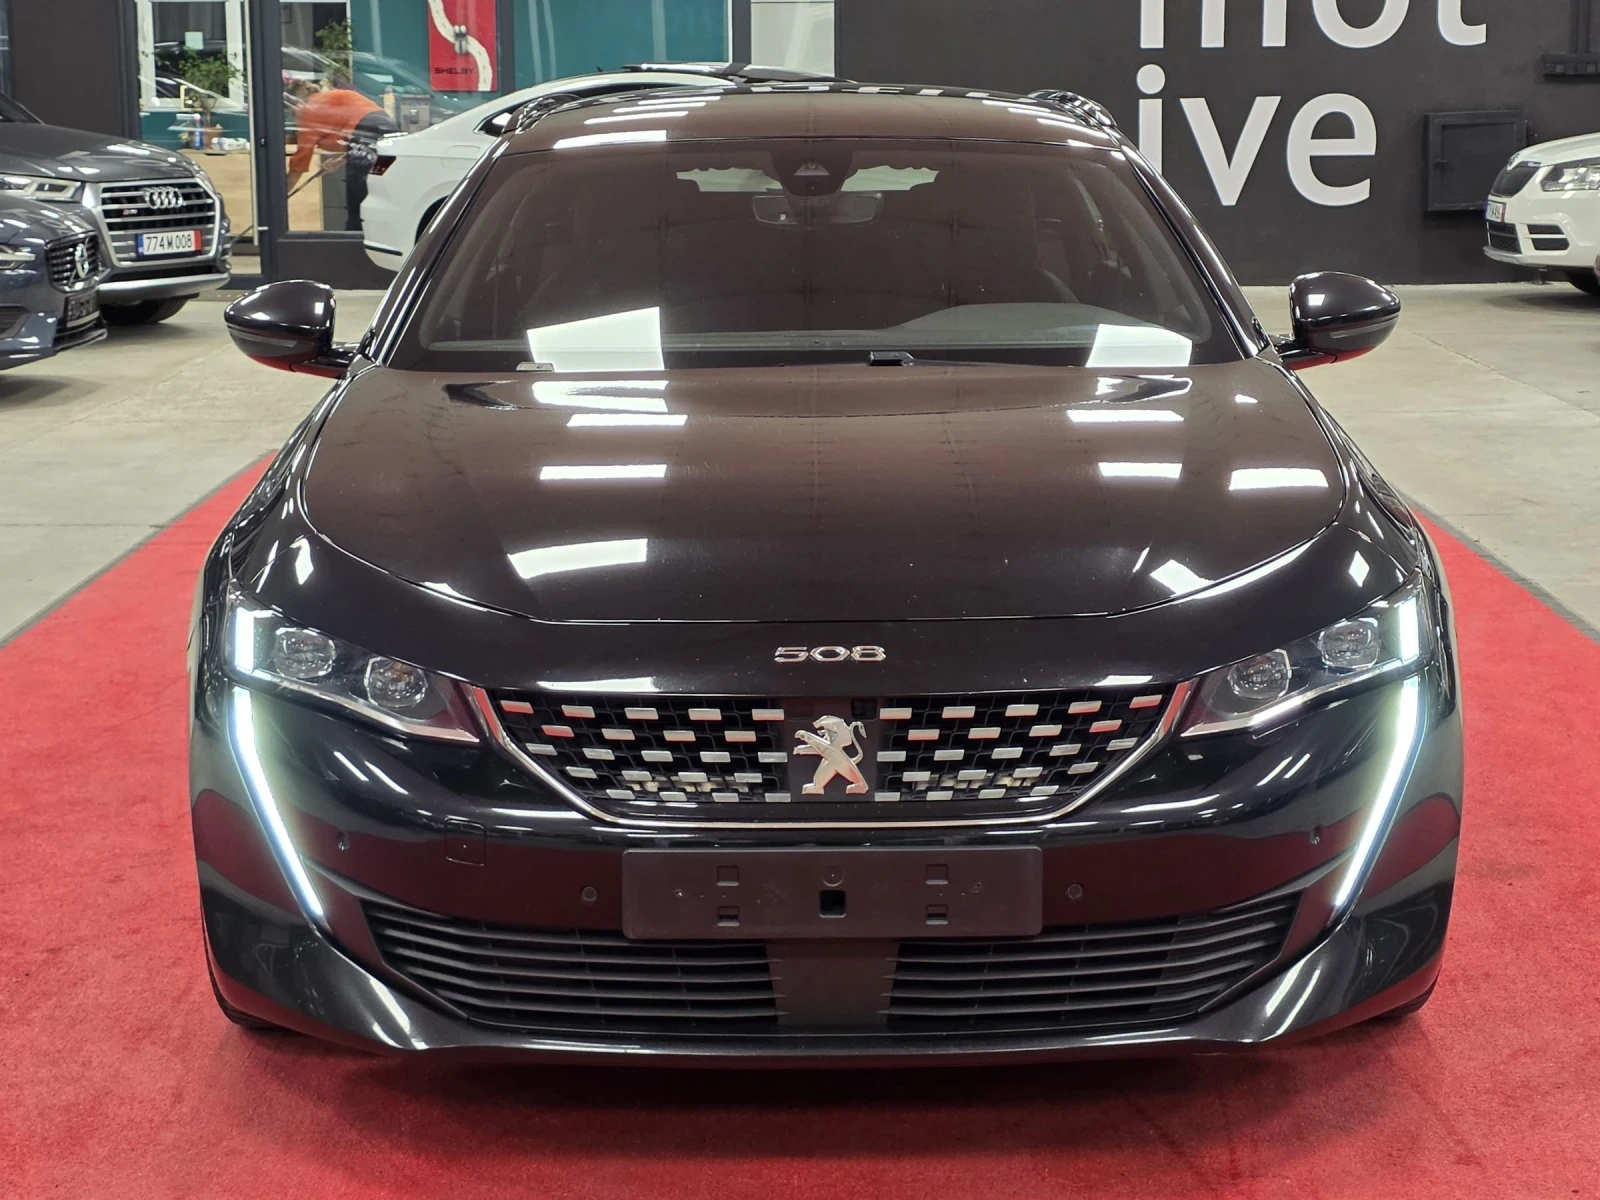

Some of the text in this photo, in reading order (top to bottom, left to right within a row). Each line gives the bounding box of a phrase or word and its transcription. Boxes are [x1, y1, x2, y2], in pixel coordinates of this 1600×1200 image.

[434, 67, 475, 75] SHELBY
[1136, 64, 1377, 207] ive
[774, 645, 887, 662] 508
